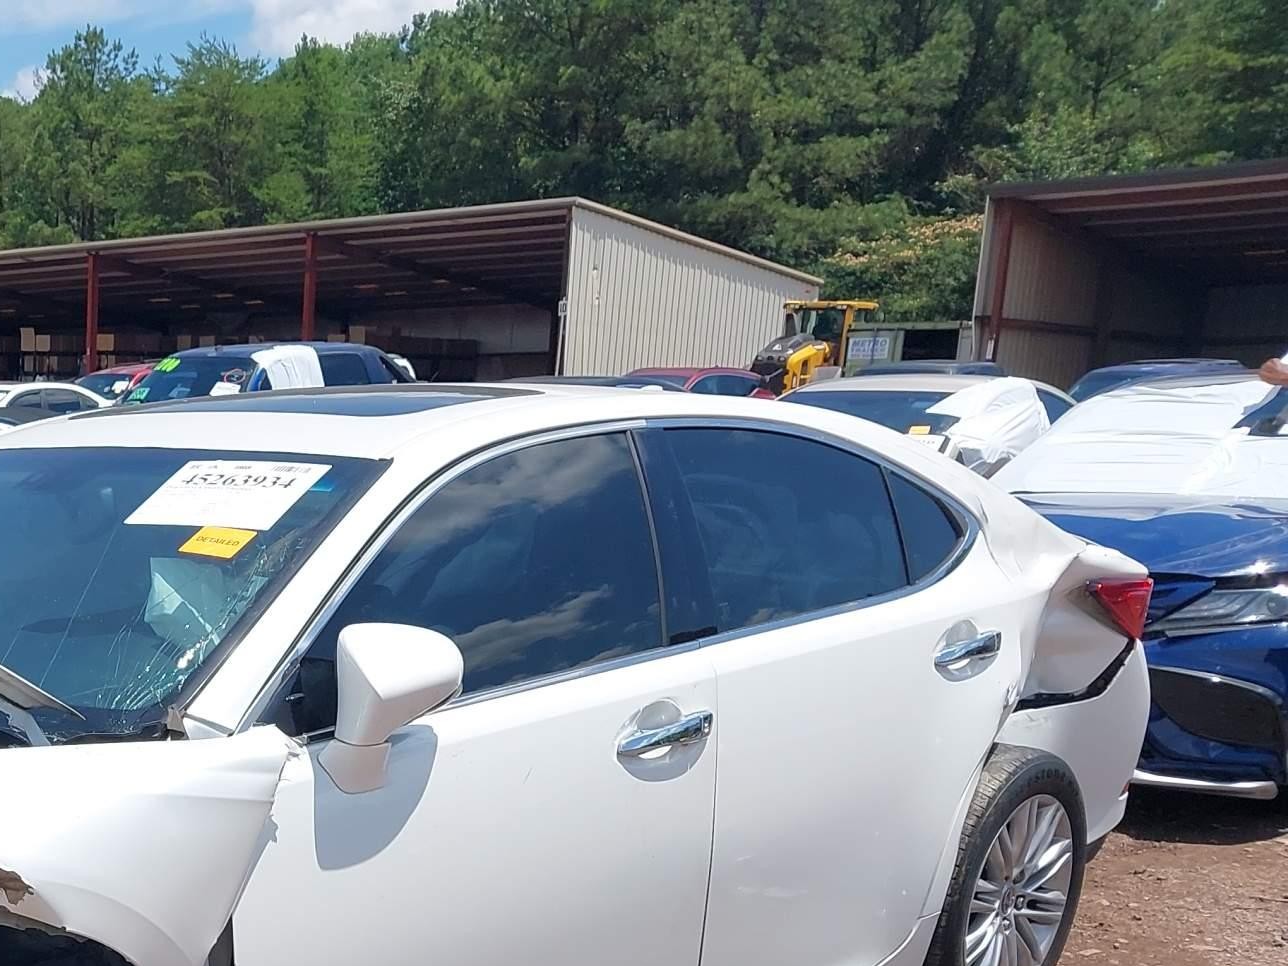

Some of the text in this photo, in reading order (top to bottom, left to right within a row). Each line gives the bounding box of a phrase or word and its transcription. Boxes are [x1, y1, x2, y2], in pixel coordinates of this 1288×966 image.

[852, 339, 887, 347] METRO
[181, 473, 297, 489] 45263934
[196, 535, 240, 546] DETAILED
